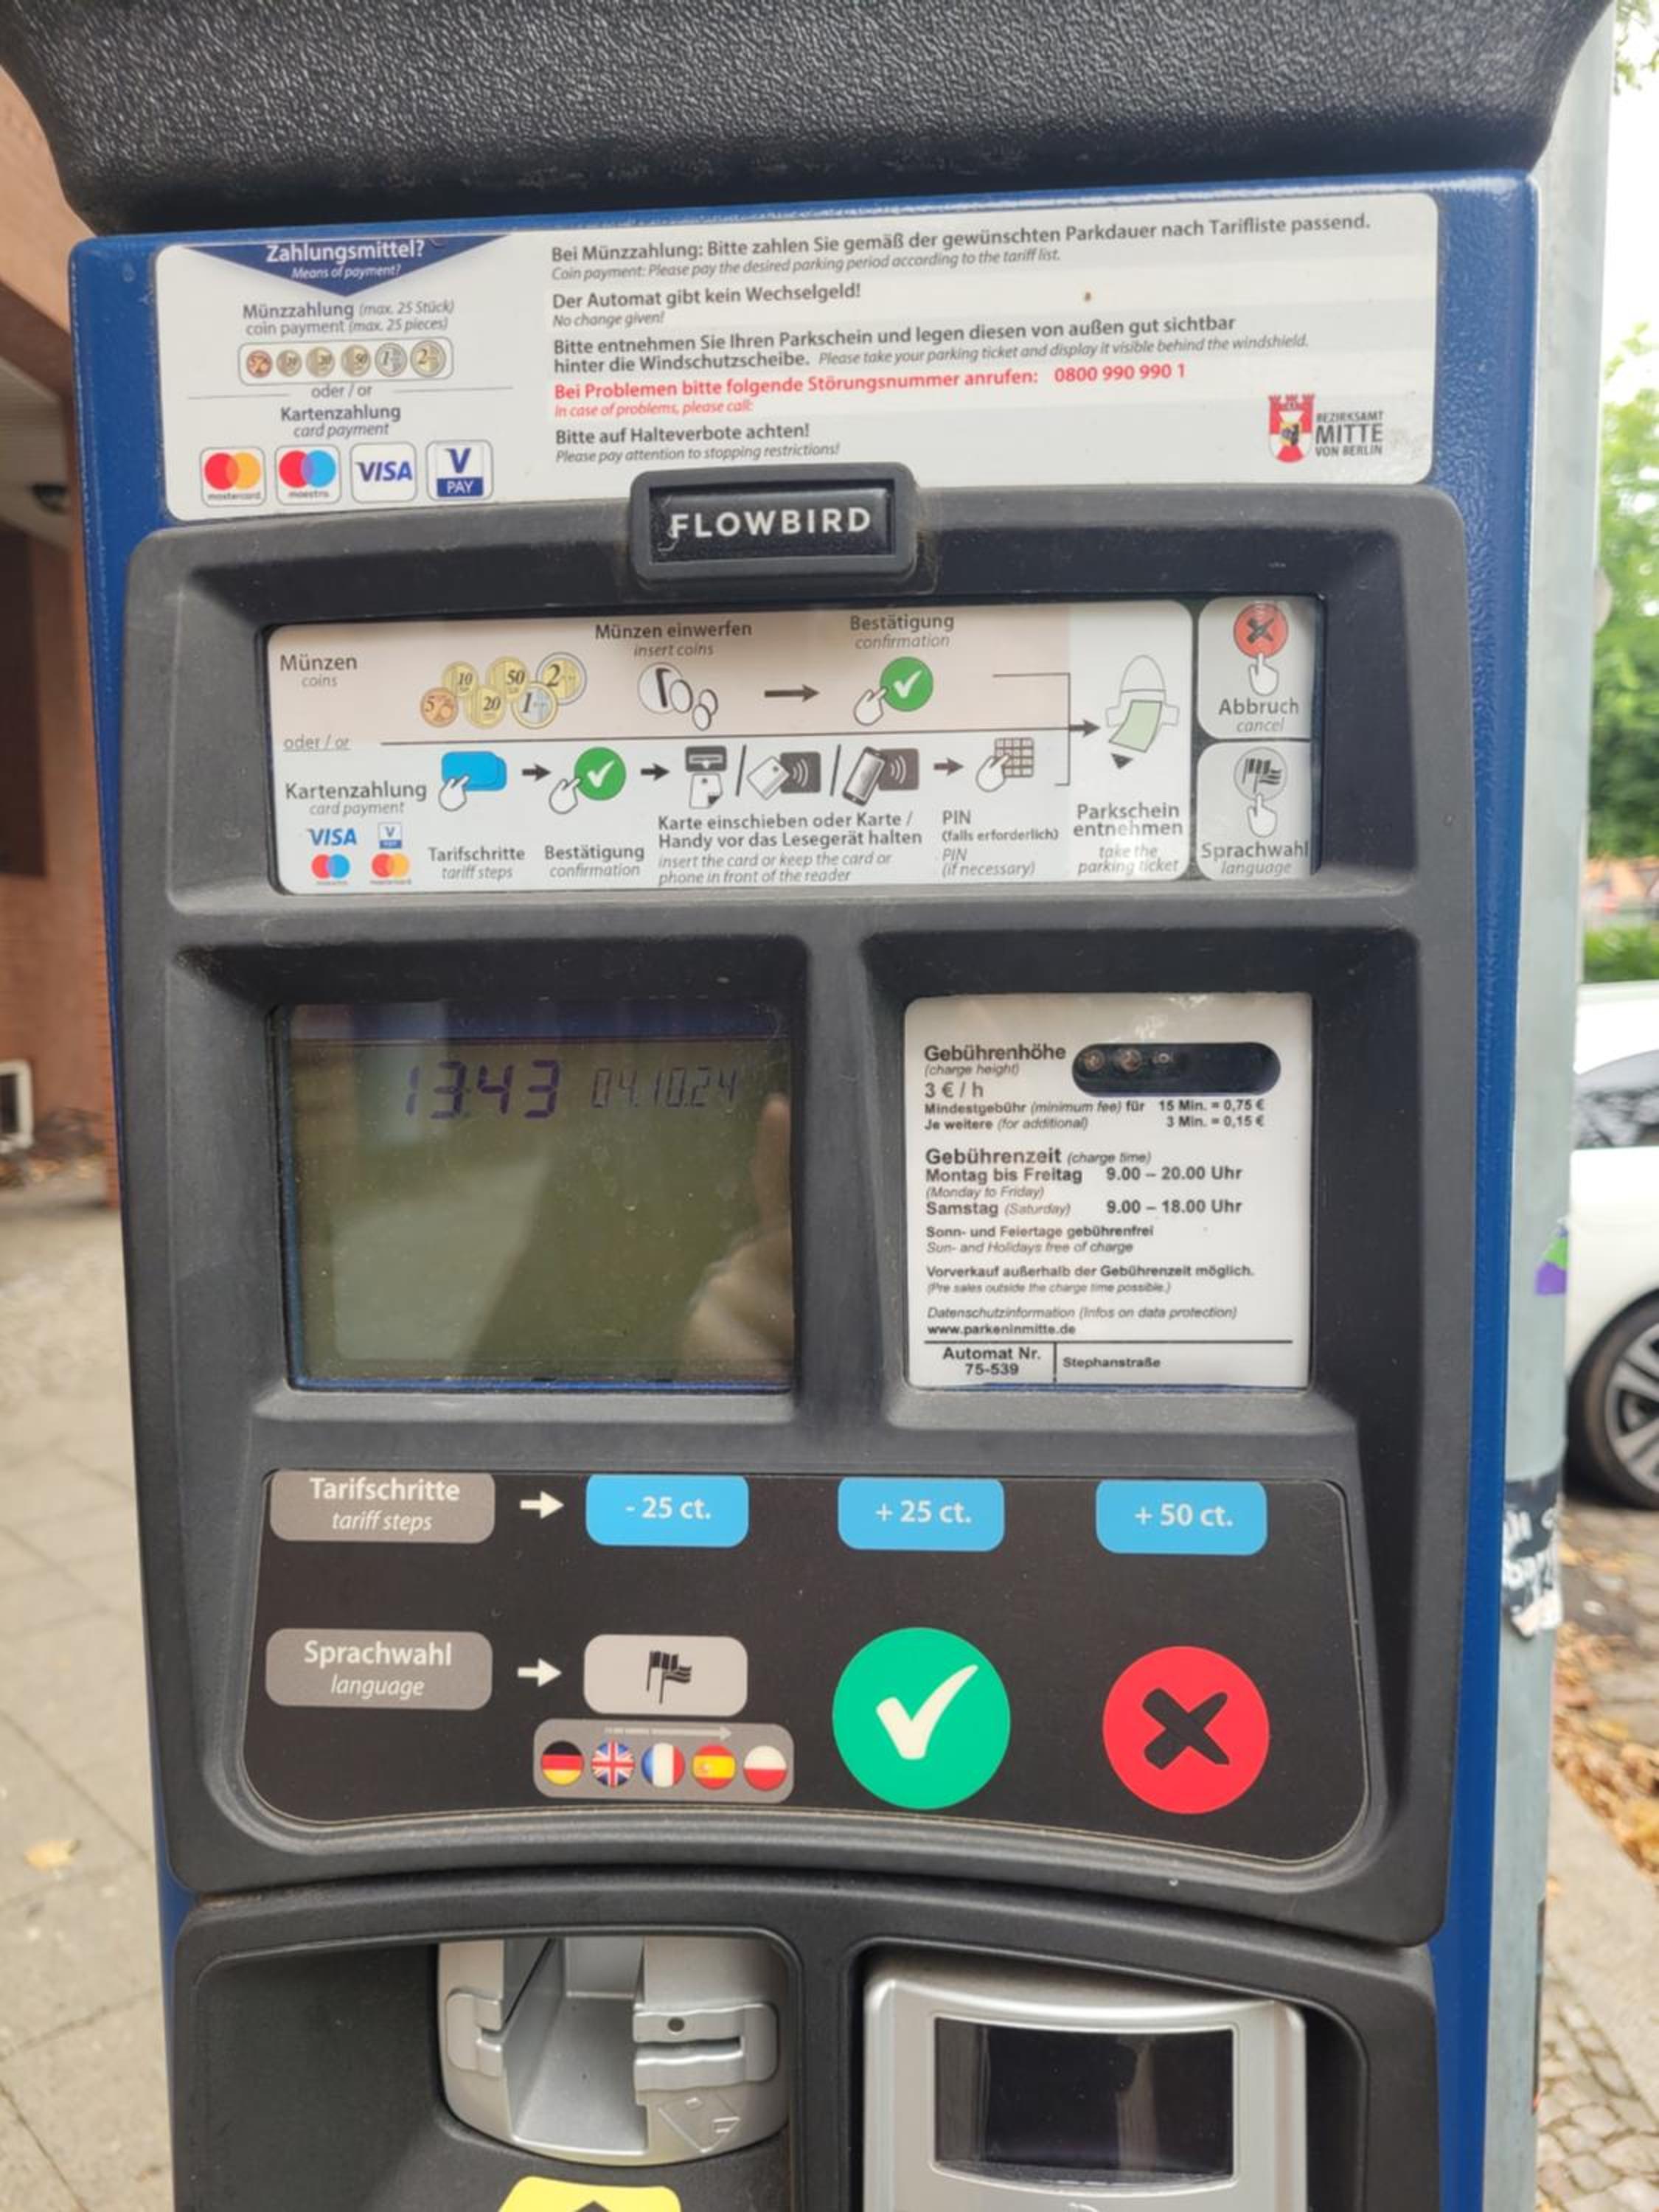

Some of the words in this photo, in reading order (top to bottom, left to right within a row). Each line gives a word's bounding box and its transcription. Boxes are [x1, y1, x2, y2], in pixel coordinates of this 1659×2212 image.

[552, 246, 577, 262] Bei
[582, 242, 703, 261] Münzzahlung:
[708, 240, 748, 256] Bitte
[752, 238, 809, 254] zahlen
[813, 237, 840, 251] Sie
[844, 234, 903, 254] gemäß
[908, 233, 938, 248] der
[942, 227, 1060, 249] gewünschten
[1065, 225, 1157, 241] Parkdauer
[1162, 222, 1203, 237] nach
[1209, 219, 1286, 235] Tarifliste
[1291, 214, 1371, 234] passend.
[266, 240, 425, 265] Zahlungsmittel?
[292, 267, 329, 279] Means
[331, 265, 344, 279] of
[344, 265, 401, 279] payment?
[553, 293, 582, 309] Der
[588, 291, 661, 307] Automat
[666, 291, 700, 307] gibt
[705, 288, 740, 304] kein
[745, 283, 860, 302] Wechselgeld!
[243, 303, 354, 320] Münzzahlung
[358, 302, 394, 316] (max.
[397, 302, 413, 314] 25
[415, 299, 454, 315] Stück)
[553, 316, 568, 327] No
[571, 313, 622, 328] change
[625, 311, 664, 327] given!
[554, 384, 580, 400] Bei
[585, 380, 677, 397] Problemen
[682, 380, 722, 394] bitte
[726, 376, 803, 396] folgende
[807, 373, 959, 393] Störungsnummer
[964, 370, 1038, 386] anrufen:
[1055, 367, 1098, 383] 0800
[1102, 366, 1135, 381] 990
[1139, 364, 1172, 380] 990
[1178, 364, 1186, 378] 1
[280, 406, 401, 423] Kartenzahlung
[1316, 411, 1383, 422] BEZIRKSAMT
[293, 424, 324, 438] card
[327, 423, 389, 439] payment
[555, 429, 594, 445] Bitte
[599, 428, 627, 443] auf
[631, 425, 742, 442] Halteverbote
[745, 423, 810, 439] achten!
[1315, 424, 1383, 443] MITTE
[1315, 446, 1340, 456] VON
[1343, 445, 1382, 456] BERLIN
[355, 462, 413, 481] VISA
[447, 481, 473, 493] PAY
[671, 507, 871, 538] FLOWBIRD
[595, 625, 662, 639] Münzen
[667, 622, 752, 637] einwerfen
[849, 615, 954, 633] Bestätigung
[634, 644, 674, 657] insert
[677, 643, 714, 655] coins
[855, 635, 950, 649] confirmation
[280, 655, 358, 671] Münzen
[1219, 699, 1298, 715] Abbruch
[1237, 718, 1284, 732] cancel
[285, 782, 427, 801] Kartenzahlung
[310, 802, 340, 815] card
[342, 802, 404, 816] payment
[1077, 803, 1179, 820] Parkschein
[658, 815, 702, 831] Karte
[707, 813, 808, 829] einschieben
[813, 814, 852, 827] oder
[856, 812, 902, 827] Karte
[942, 810, 971, 826] PIN
[308, 829, 357, 846] VISA
[942, 830, 973, 843] (falls
[977, 828, 1059, 842] erforderlich)
[1074, 823, 1183, 837] entnehmen
[658, 834, 714, 850] Handy
[717, 836, 744, 847] vor
[748, 832, 777, 847] das
[782, 830, 863, 849] Lesegerät
[869, 830, 922, 845] halten
[428, 847, 525, 862] Tarifschritte
[544, 845, 644, 862] Bestätigung
[1201, 843, 1309, 864] Sprachwahl
[442, 866, 475, 879] tariff
[478, 866, 513, 880] steps
[549, 863, 640, 879] confirmation
[1221, 860, 1292, 876] language
[925, 1045, 1066, 1062] Gebührenhöhe
[925, 1063, 972, 1077] (charge
[975, 1063, 1020, 1076] height)
[592, 1068, 737, 1107] 04.10.24
[925, 1082, 935, 1098] 3
[942, 1082, 955, 1097] €
[973, 1081, 984, 1097] h
[925, 1102, 1026, 1116] Mindestgebühr
[1030, 1102, 1092, 1115] (minimum
[1097, 1101, 1121, 1114] fee)
[1126, 1100, 1144, 1112] für
[1160, 1100, 1174, 1111] 15
[1179, 1100, 1207, 1111] Min.
[1223, 1099, 1252, 1112] 0,75
[1256, 1099, 1265, 1110] €
[925, 1148, 1062, 1164] Gebührenzeit
[1067, 1152, 1115, 1166] (charge
[1119, 1151, 1151, 1164] time)
[925, 1169, 987, 1185] Montag
[993, 1169, 1018, 1181] bis
[1024, 1168, 1082, 1184] Freitag
[1106, 1166, 1141, 1180] 9.00
[1161, 1166, 1206, 1180] 20.00
[1211, 1166, 1242, 1180] Uhr
[926, 1202, 998, 1218] Samstag
[1004, 1203, 1071, 1217] (Saturday)
[1106, 1200, 1141, 1214] 9.00
[1162, 1200, 1206, 1214] 18.00
[1211, 1200, 1242, 1213] Uhr
[926, 1226, 966, 1238] Sonn-
[970, 1226, 995, 1238] und
[1000, 1225, 1062, 1239] Feiertage
[1067, 1225, 1154, 1239] gebührenfrei
[927, 1265, 999, 1279] Vorverkauf
[1003, 1265, 1070, 1278] außerhalb
[1074, 1265, 1096, 1277] der
[1101, 1265, 1191, 1278] Gebührenzeit
[1195, 1265, 1254, 1279] möglich.
[928, 1323, 1076, 1337] www.parkeninmitte.de
[943, 1346, 1013, 1360] Automat
[1018, 1346, 1041, 1359] Nr.
[965, 1363, 1019, 1375] 75-539
[1063, 1356, 1160, 1369] Stephanstraße
[310, 1478, 461, 1501] Tarifschritte
[641, 1495, 672, 1519] 25
[681, 1497, 712, 1520] ct.
[876, 1504, 893, 1523] +
[900, 1499, 931, 1523] 25
[939, 1500, 972, 1524] ct.
[1135, 1506, 1153, 1526] +
[1160, 1503, 1192, 1527] 50
[1200, 1503, 1234, 1528] ct.
[332, 1512, 380, 1531] tariff
[383, 1512, 433, 1533] steps
[304, 1641, 452, 1669] Sprachwahl
[330, 1677, 424, 1698] language
